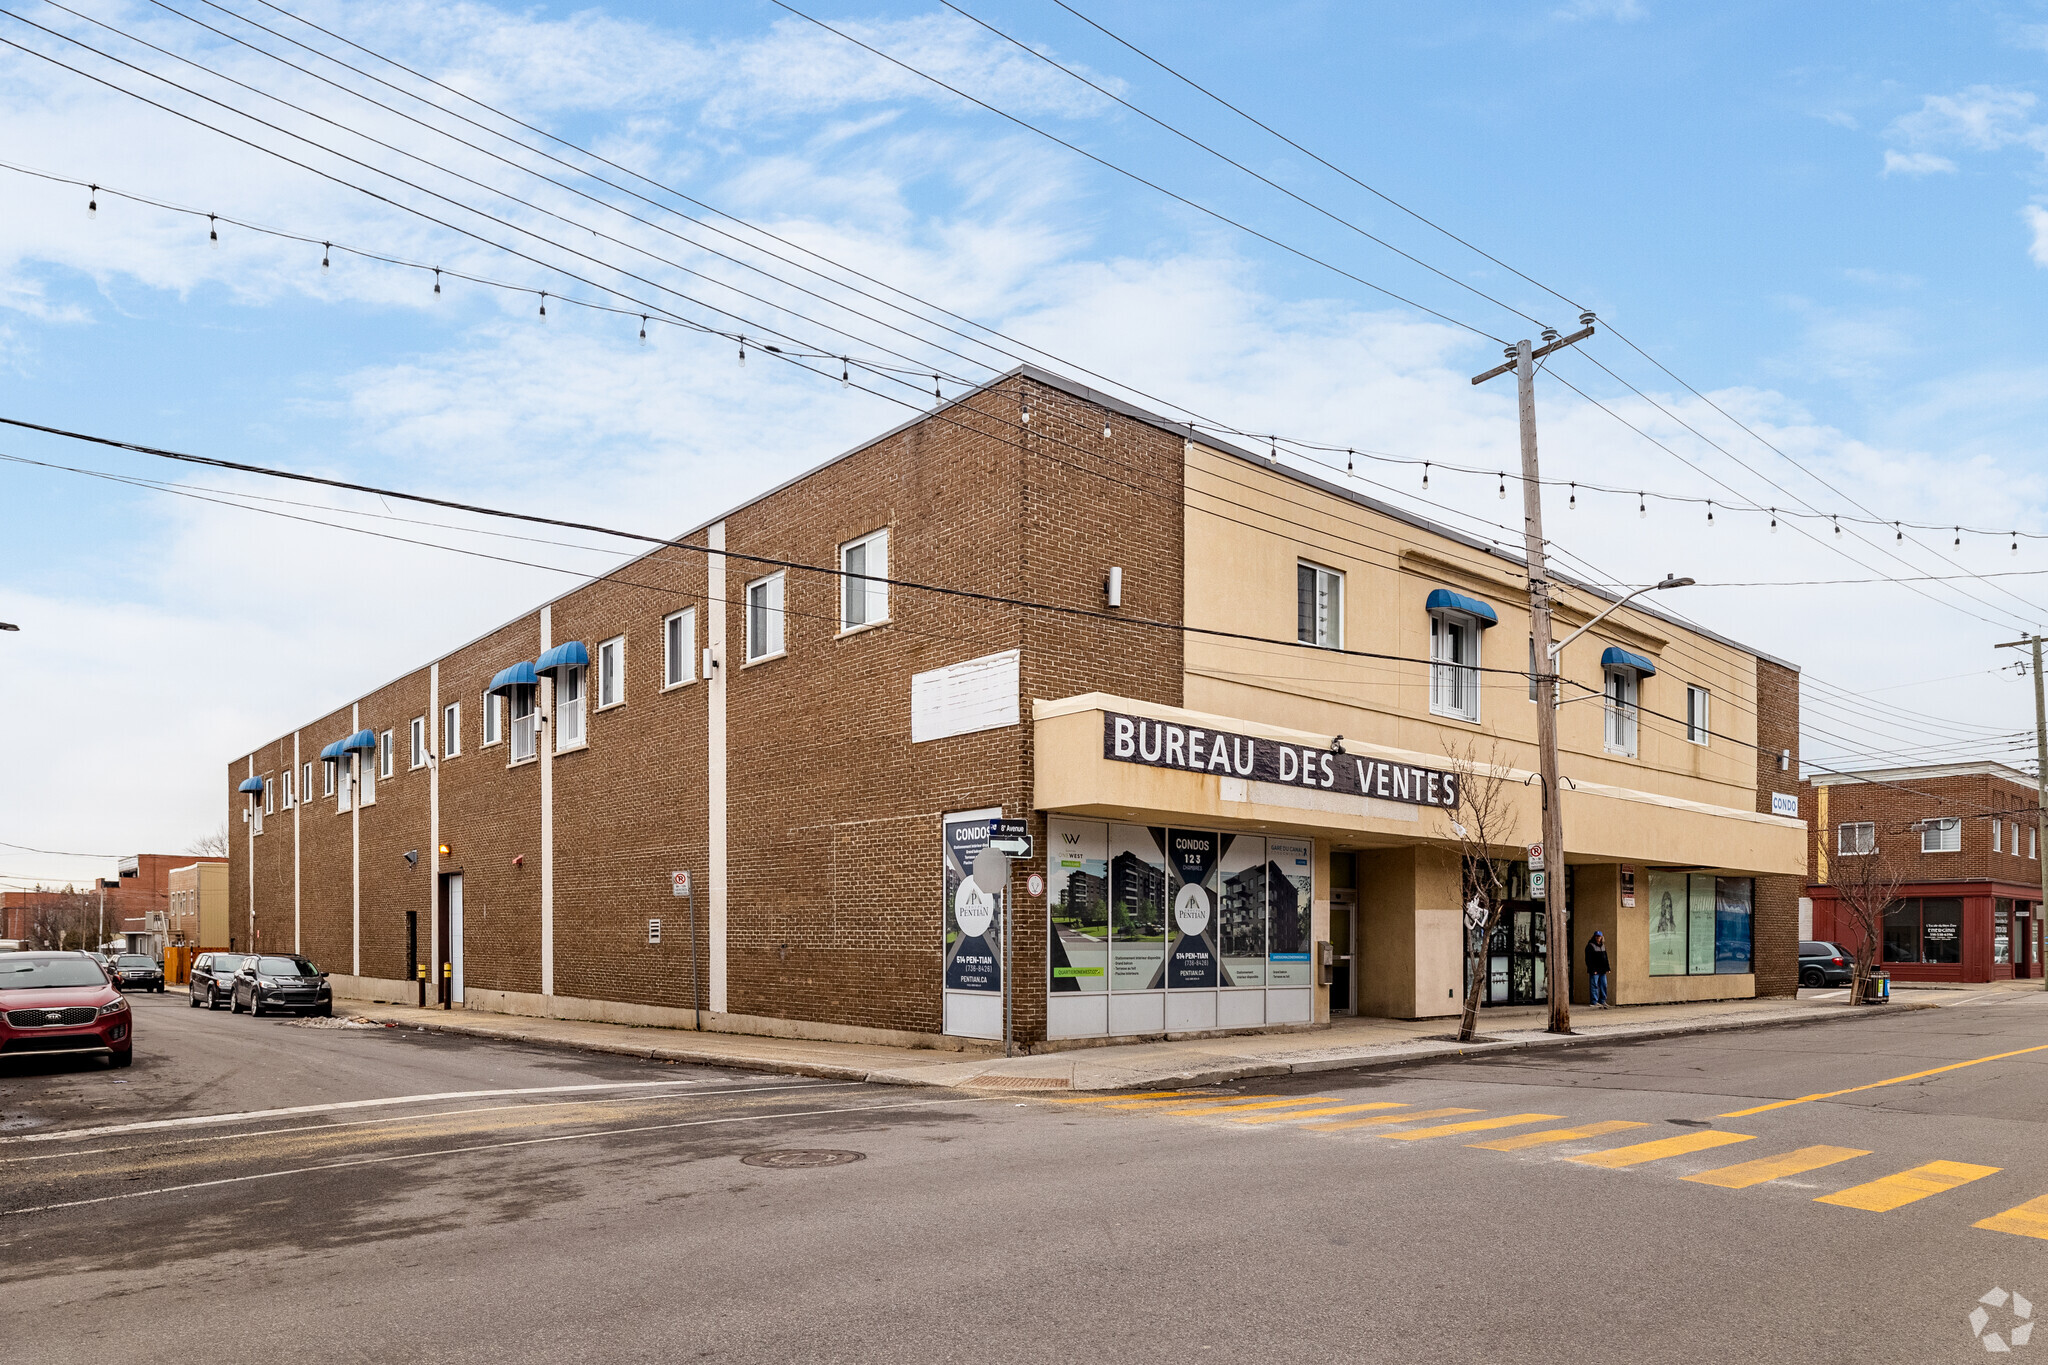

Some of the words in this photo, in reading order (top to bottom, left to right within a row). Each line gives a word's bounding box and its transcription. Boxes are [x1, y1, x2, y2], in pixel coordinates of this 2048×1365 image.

[1113, 716, 1254, 776] BUREAU
[1278, 745, 1335, 788] DES
[1356, 759, 1456, 805] VENTES
[1773, 797, 1797, 811] CONDO
[1006, 825, 1025, 833] Avenue
[1176, 838, 1210, 851] CONDOS
[960, 907, 989, 917] PENTIAN
[1179, 910, 1206, 919] PENTIAN
[956, 955, 966, 964] 514
[966, 955, 992, 964] PEN-TIAN
[1176, 952, 1185, 960] 514
[1185, 952, 1209, 960] PEN-TIAN
[960, 975, 988, 983] PENTIAN.CA
